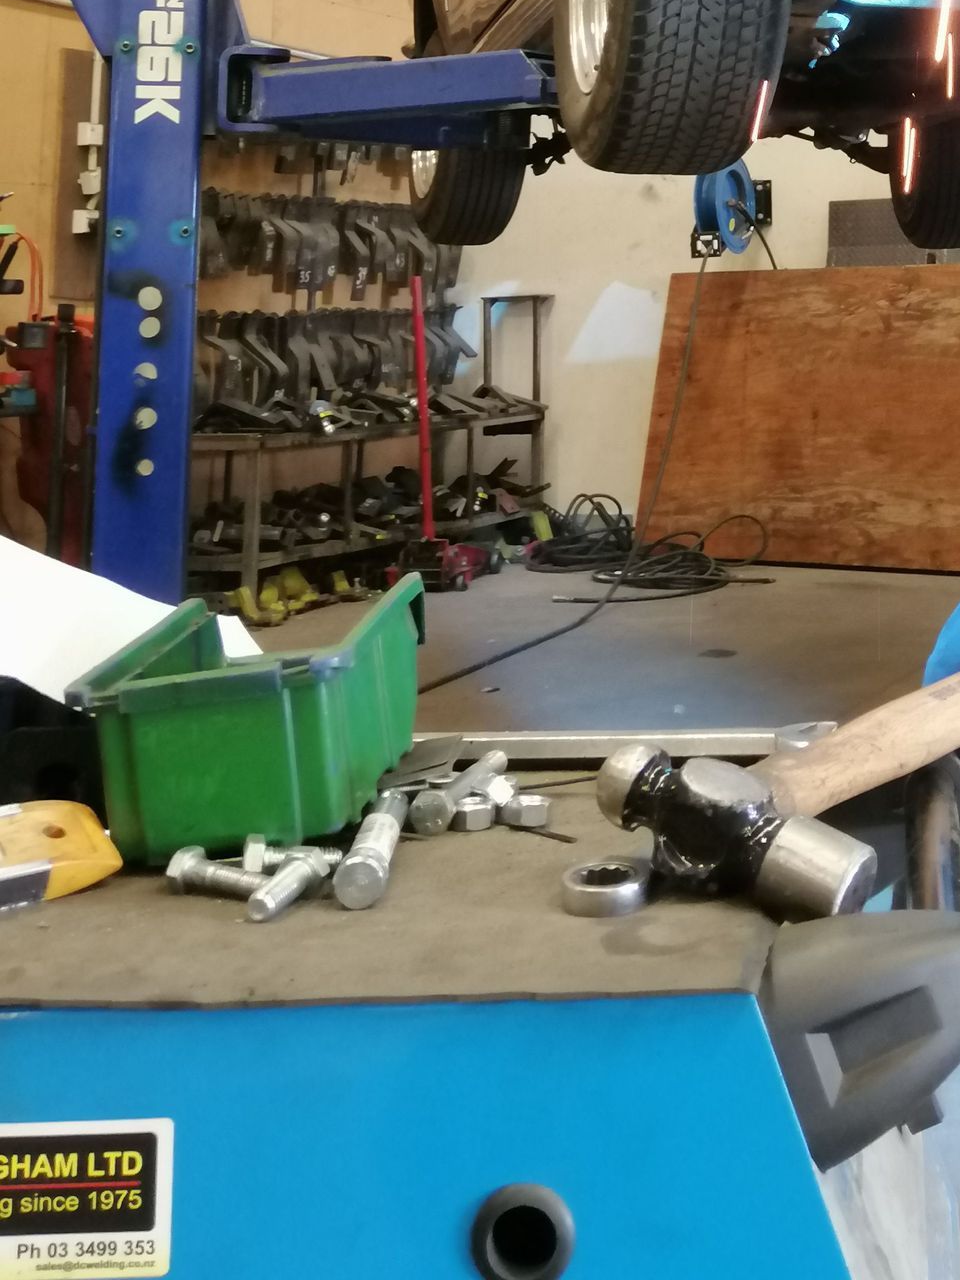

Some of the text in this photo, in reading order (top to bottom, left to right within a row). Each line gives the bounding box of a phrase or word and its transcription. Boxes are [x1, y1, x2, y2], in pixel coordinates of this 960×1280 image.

[87, 1150, 143, 1177] LTD
[20, 1192, 79, 1213] since
[88, 1189, 142, 1210] 1975
[17, 1240, 155, 1260] Ph 03 3499 353
